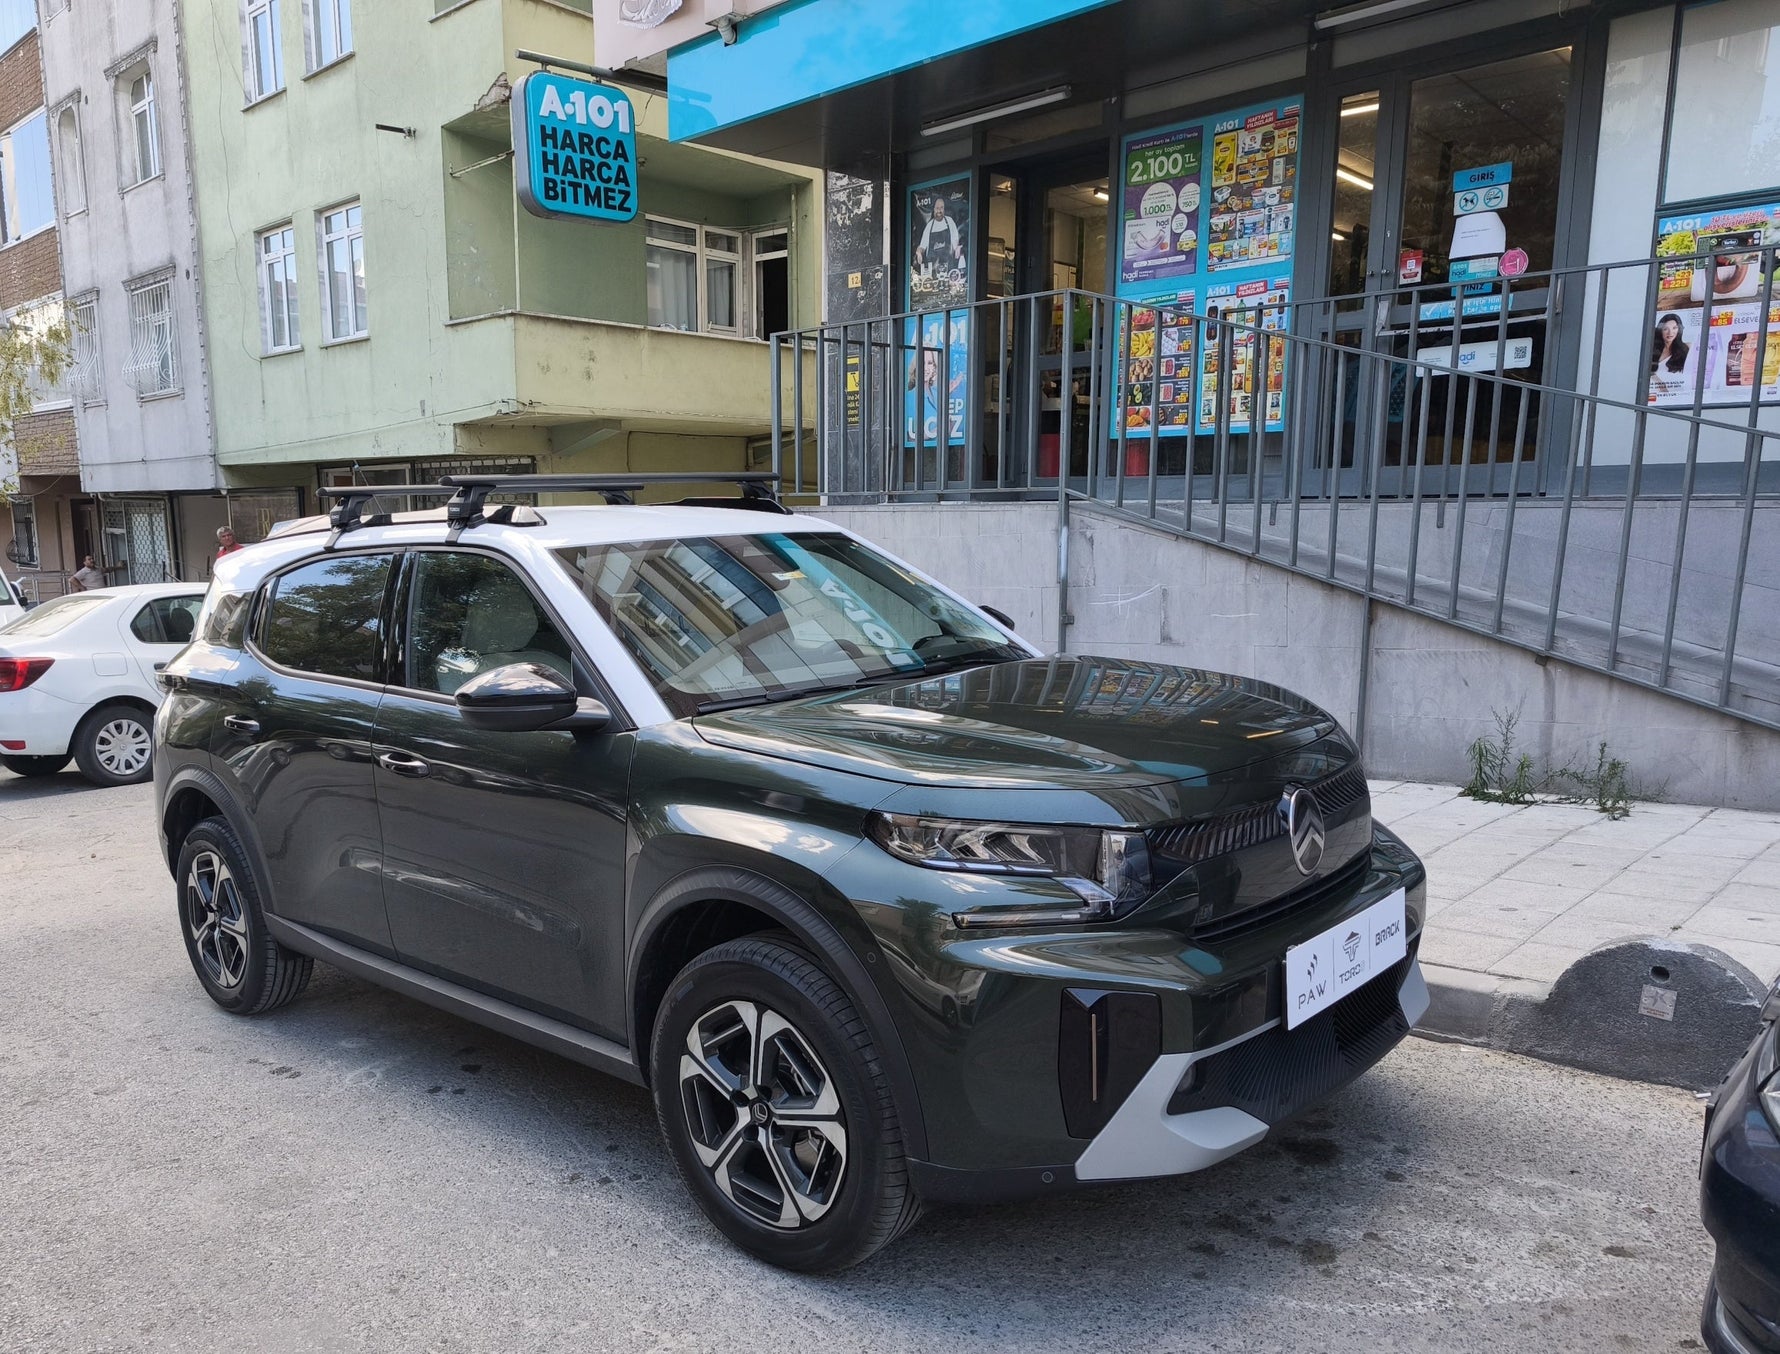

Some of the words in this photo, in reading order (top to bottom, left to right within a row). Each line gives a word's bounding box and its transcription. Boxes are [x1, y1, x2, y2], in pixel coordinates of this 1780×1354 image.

[540, 125, 629, 162] HARCA
[542, 151, 630, 187] HARCA
[1131, 153, 1183, 182] 2.100
[1184, 153, 1196, 163] TL
[1144, 204, 1166, 216] 1.000
[1459, 351, 1476, 362] adi
[1375, 920, 1400, 946] BRACK
[1298, 980, 1327, 1010] PAW
